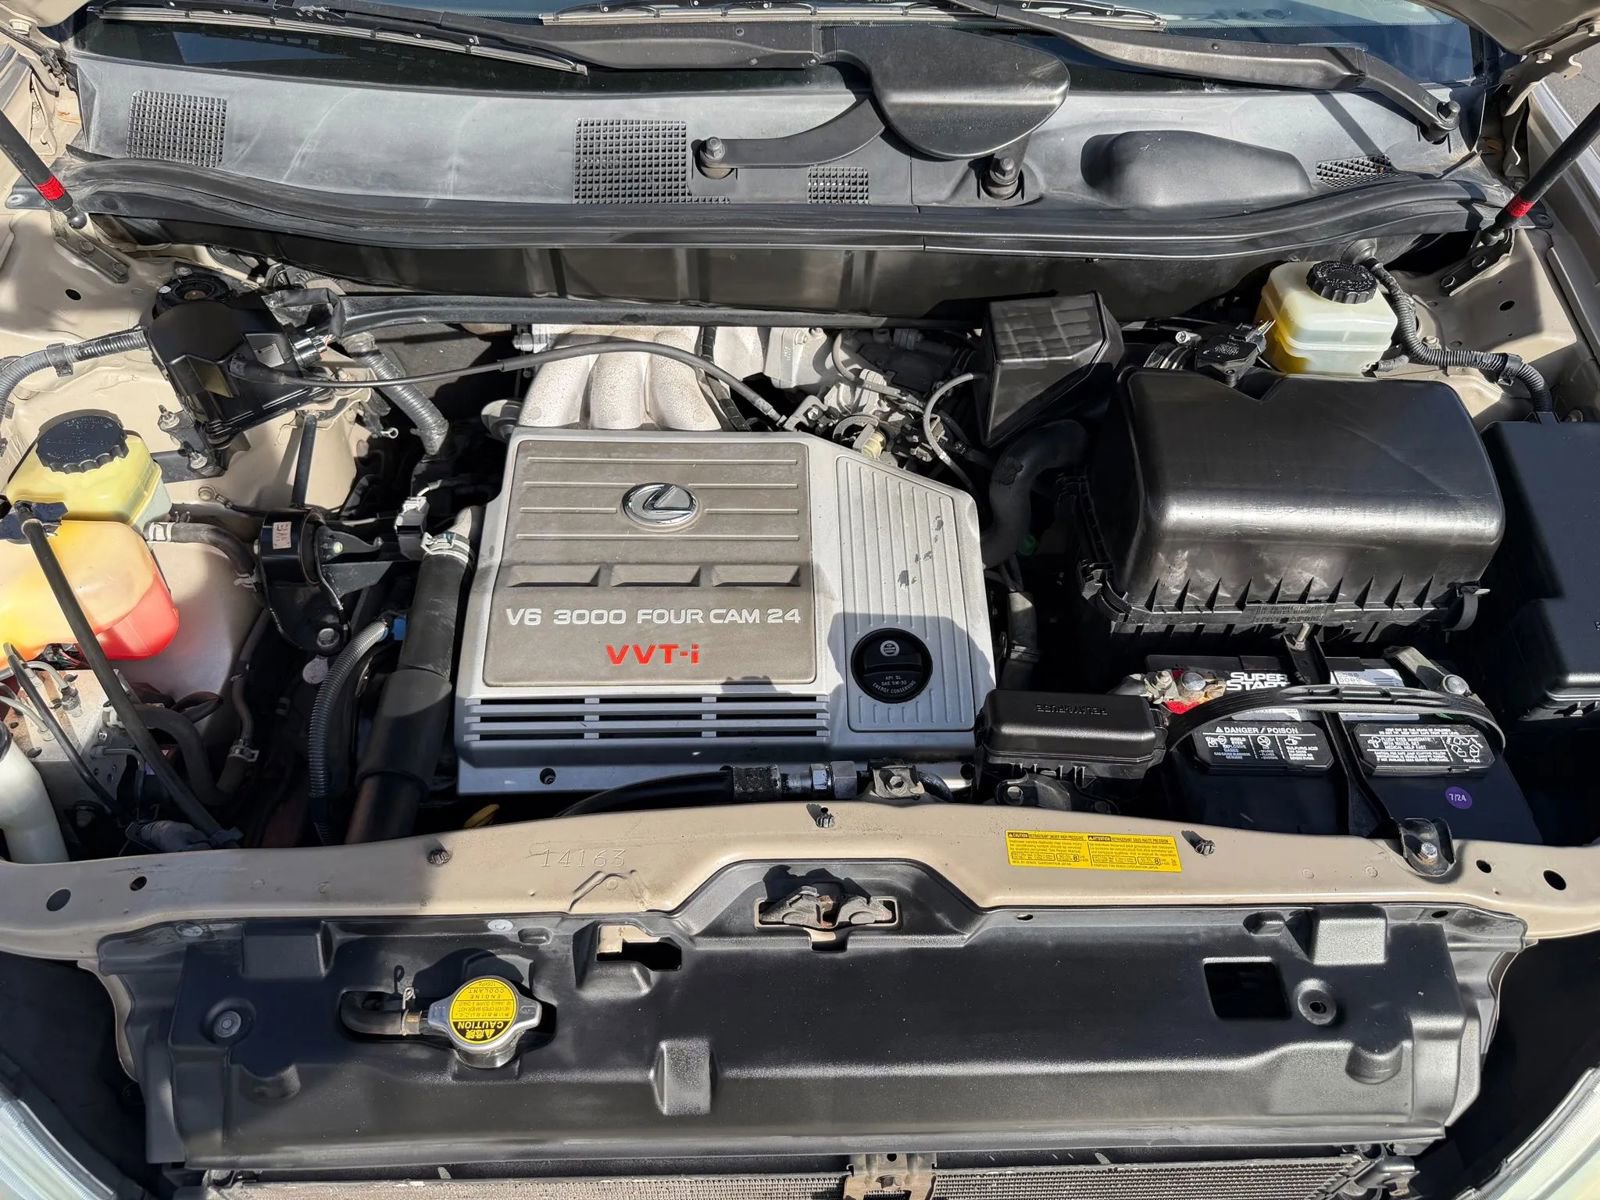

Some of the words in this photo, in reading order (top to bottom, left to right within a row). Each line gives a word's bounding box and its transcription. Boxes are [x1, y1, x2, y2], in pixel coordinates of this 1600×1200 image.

[506, 608, 542, 626] V6
[553, 609, 627, 625] 3000
[636, 609, 704, 624] FOUR
[709, 608, 760, 624] CAM
[767, 608, 801, 624] 24
[605, 643, 699, 666] VVT-i
[1229, 671, 1288, 682] SUPER
[1224, 726, 1260, 734] DANGER
[541, 848, 626, 867] 14163
[457, 1021, 504, 1029] CAUTION
